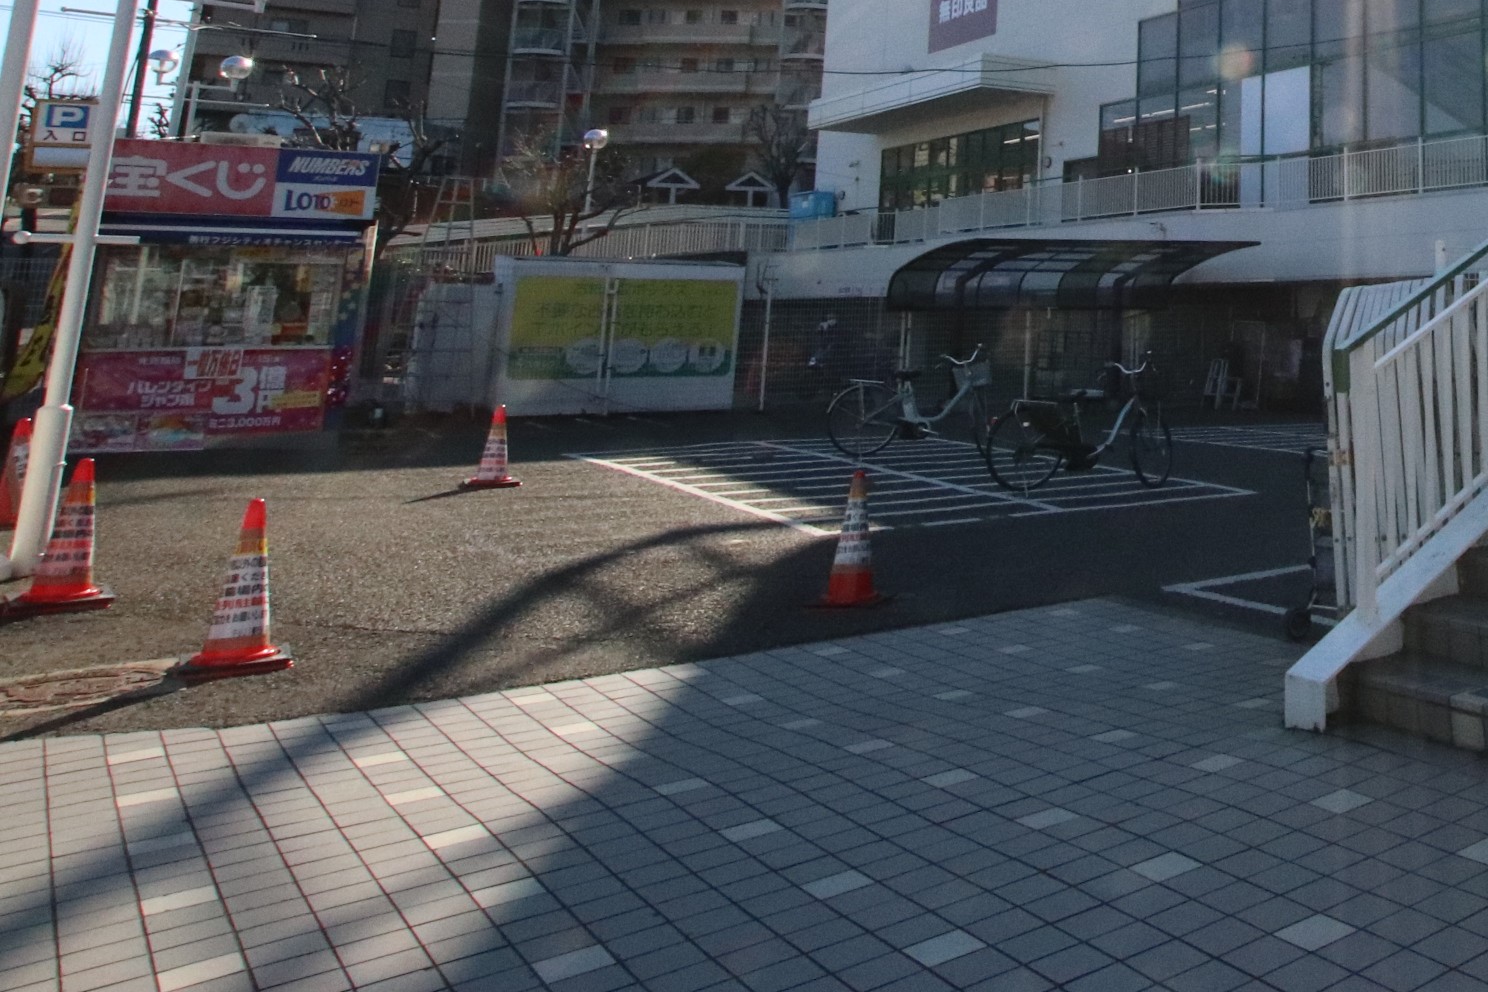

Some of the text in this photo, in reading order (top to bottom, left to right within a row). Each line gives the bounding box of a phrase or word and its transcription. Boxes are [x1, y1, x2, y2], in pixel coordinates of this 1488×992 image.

[51, 105, 84, 127] P
[43, 129, 87, 142] 入口
[288, 156, 370, 176] NUMBERS
[105, 155, 267, 201] 宝くじ
[283, 189, 331, 211] LOTO
